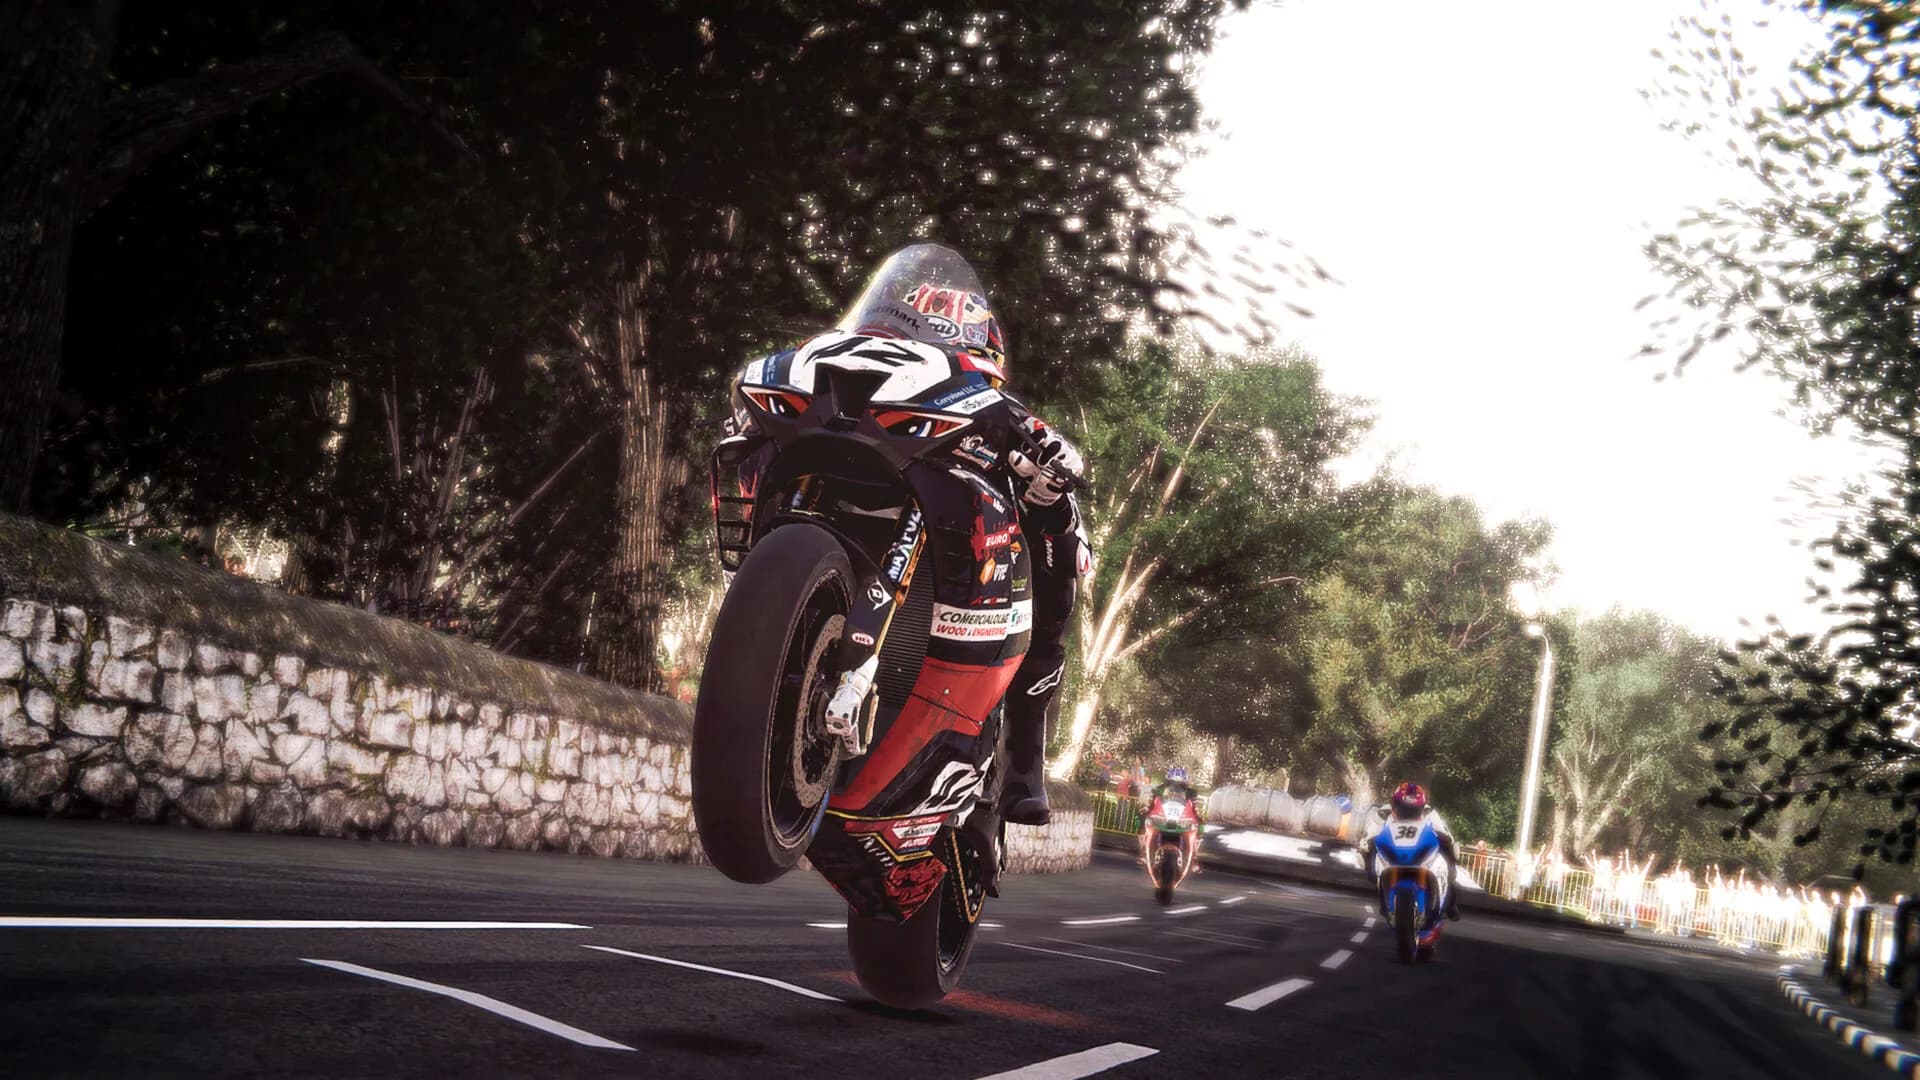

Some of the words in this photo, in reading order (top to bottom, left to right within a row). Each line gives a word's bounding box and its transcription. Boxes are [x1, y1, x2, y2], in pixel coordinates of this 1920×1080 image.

[985, 533, 1008, 547] EURO
[936, 624, 967, 636] WOOD
[1395, 825, 1418, 840] 38
